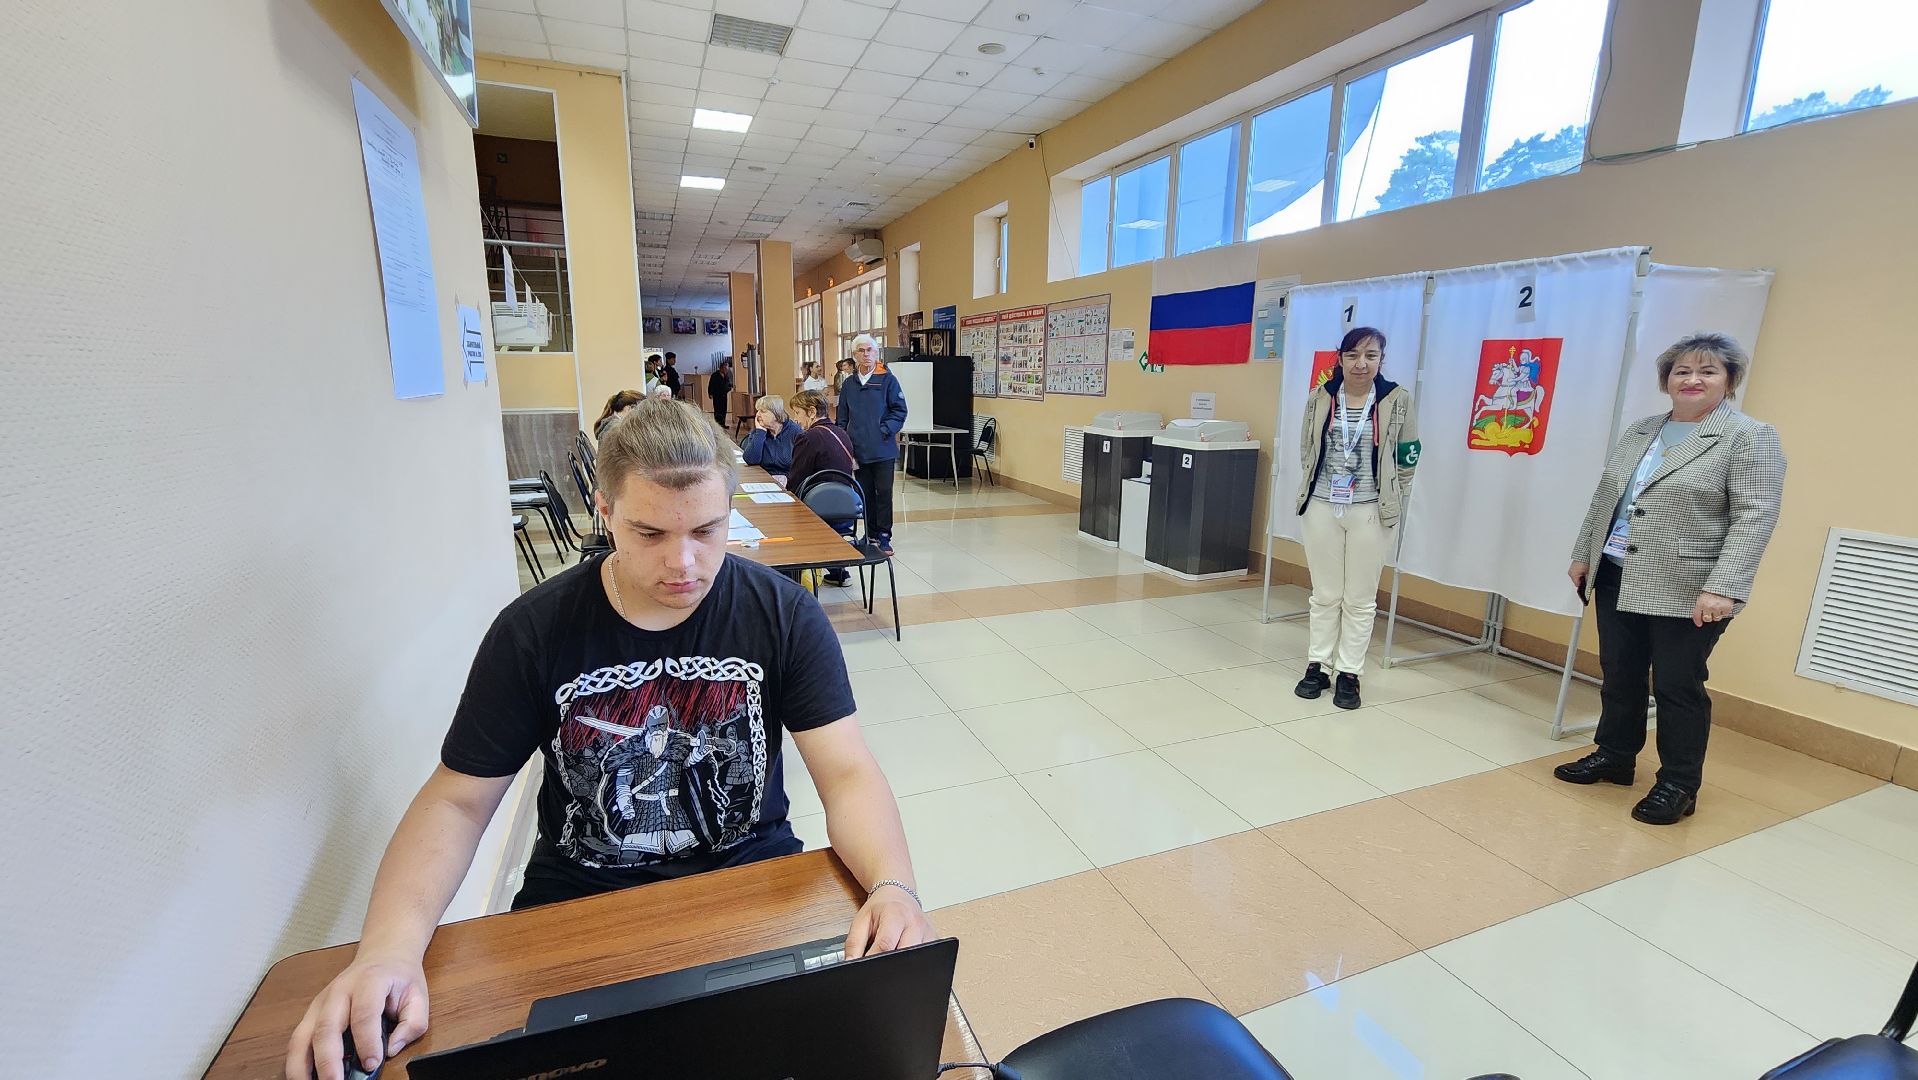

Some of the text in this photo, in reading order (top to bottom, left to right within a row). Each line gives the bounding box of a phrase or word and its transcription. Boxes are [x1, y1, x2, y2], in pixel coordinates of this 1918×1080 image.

[1518, 286, 1533, 308] 2
[1344, 305, 1354, 322] 1
[516, 1058, 608, 1080] novo
